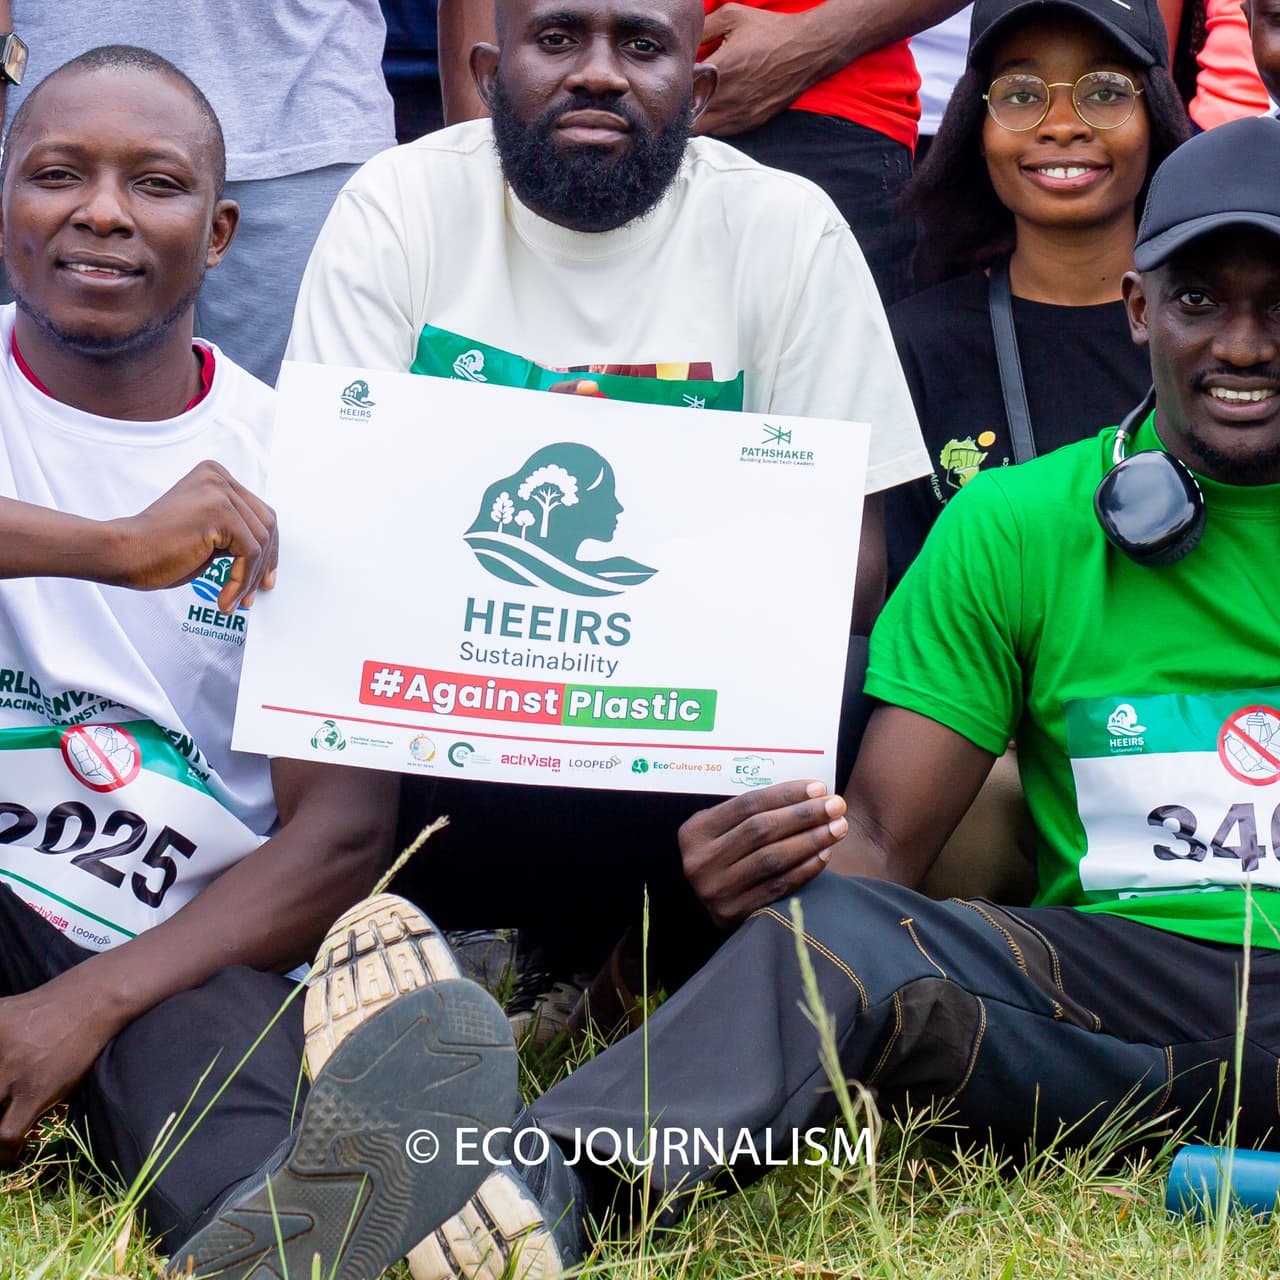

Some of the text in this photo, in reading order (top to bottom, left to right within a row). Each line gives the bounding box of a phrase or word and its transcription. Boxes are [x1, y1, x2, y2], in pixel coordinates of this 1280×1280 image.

[340, 407, 372, 419] HEEIRS
[741, 446, 815, 461] PATHSHAKER
[187, 604, 247, 633] HEEIR
[463, 596, 632, 647] HEEIRS
[181, 622, 246, 646] Sustainability
[459, 641, 620, 679] Sustainability
[369, 665, 702, 724] #Against Plastic
[1110, 737, 1145, 748] HEEIRS
[569, 758, 614, 770] LOOPED
[653, 761, 703, 773] EcoCulture
[704, 763, 723, 773] 360
[72, 925, 106, 946] LOOPED
